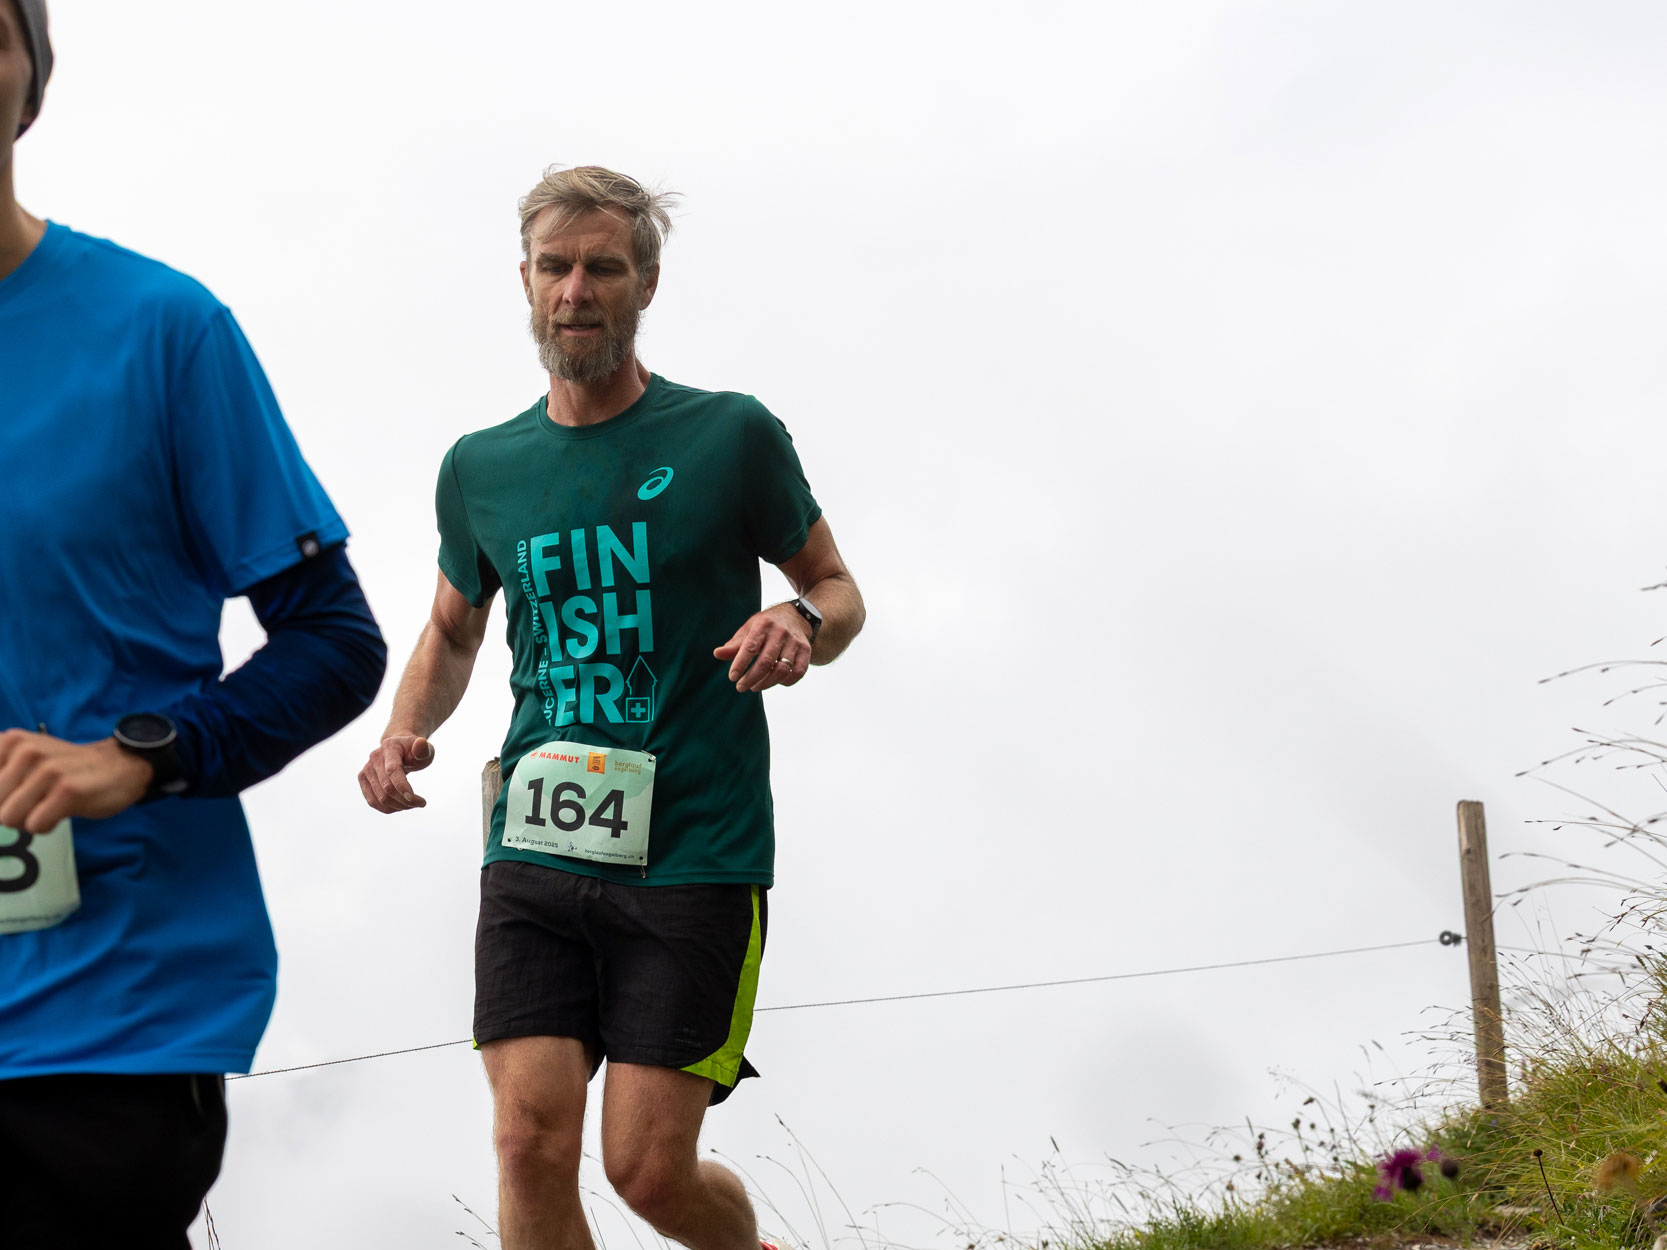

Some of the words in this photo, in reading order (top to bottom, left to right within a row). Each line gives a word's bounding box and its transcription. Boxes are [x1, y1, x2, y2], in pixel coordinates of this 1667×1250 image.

[517, 539, 548, 645] SWITZERLAND
[530, 521, 651, 598] FIN
[538, 589, 654, 662] ISH
[550, 662, 625, 727] ER
[538, 752, 580, 764] MAMMUT
[525, 776, 628, 838] 164
[522, 837, 543, 847] August
[544, 840, 559, 849] 2025
